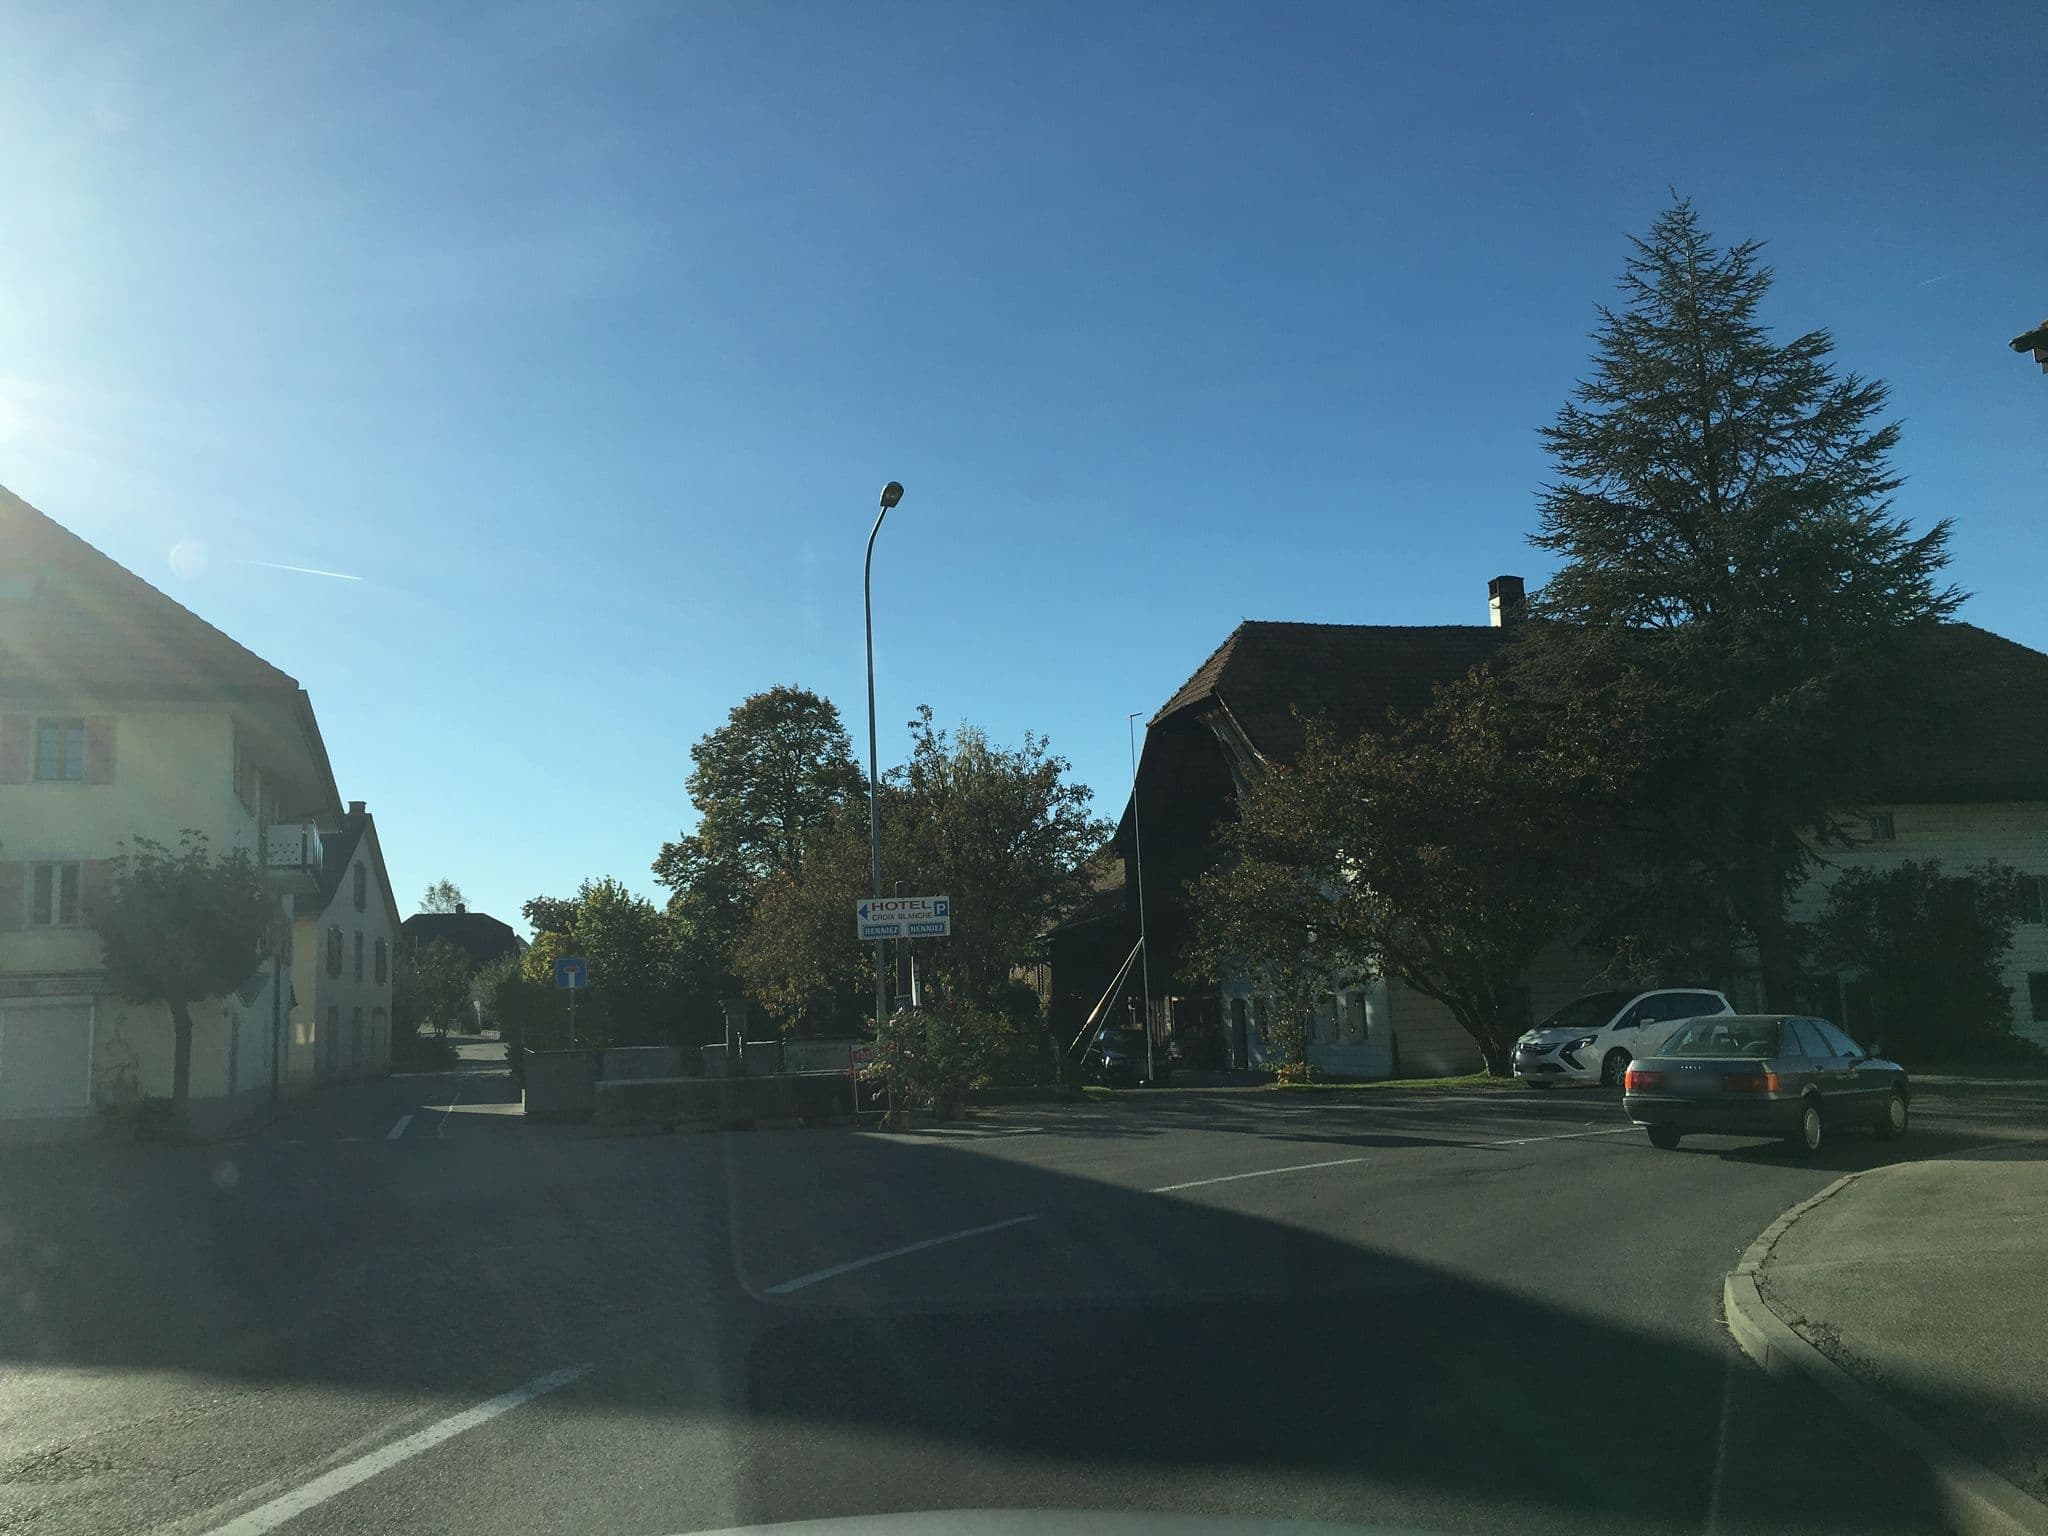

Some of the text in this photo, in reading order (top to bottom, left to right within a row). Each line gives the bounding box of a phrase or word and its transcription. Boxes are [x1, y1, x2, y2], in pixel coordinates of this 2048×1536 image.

[872, 900, 932, 911] HOTEL
[936, 903, 946, 914] P
[872, 912, 934, 921] CROIX BLANCHE
[864, 926, 898, 936] HENNIEZ
[910, 924, 944, 933] HENNIEZ
